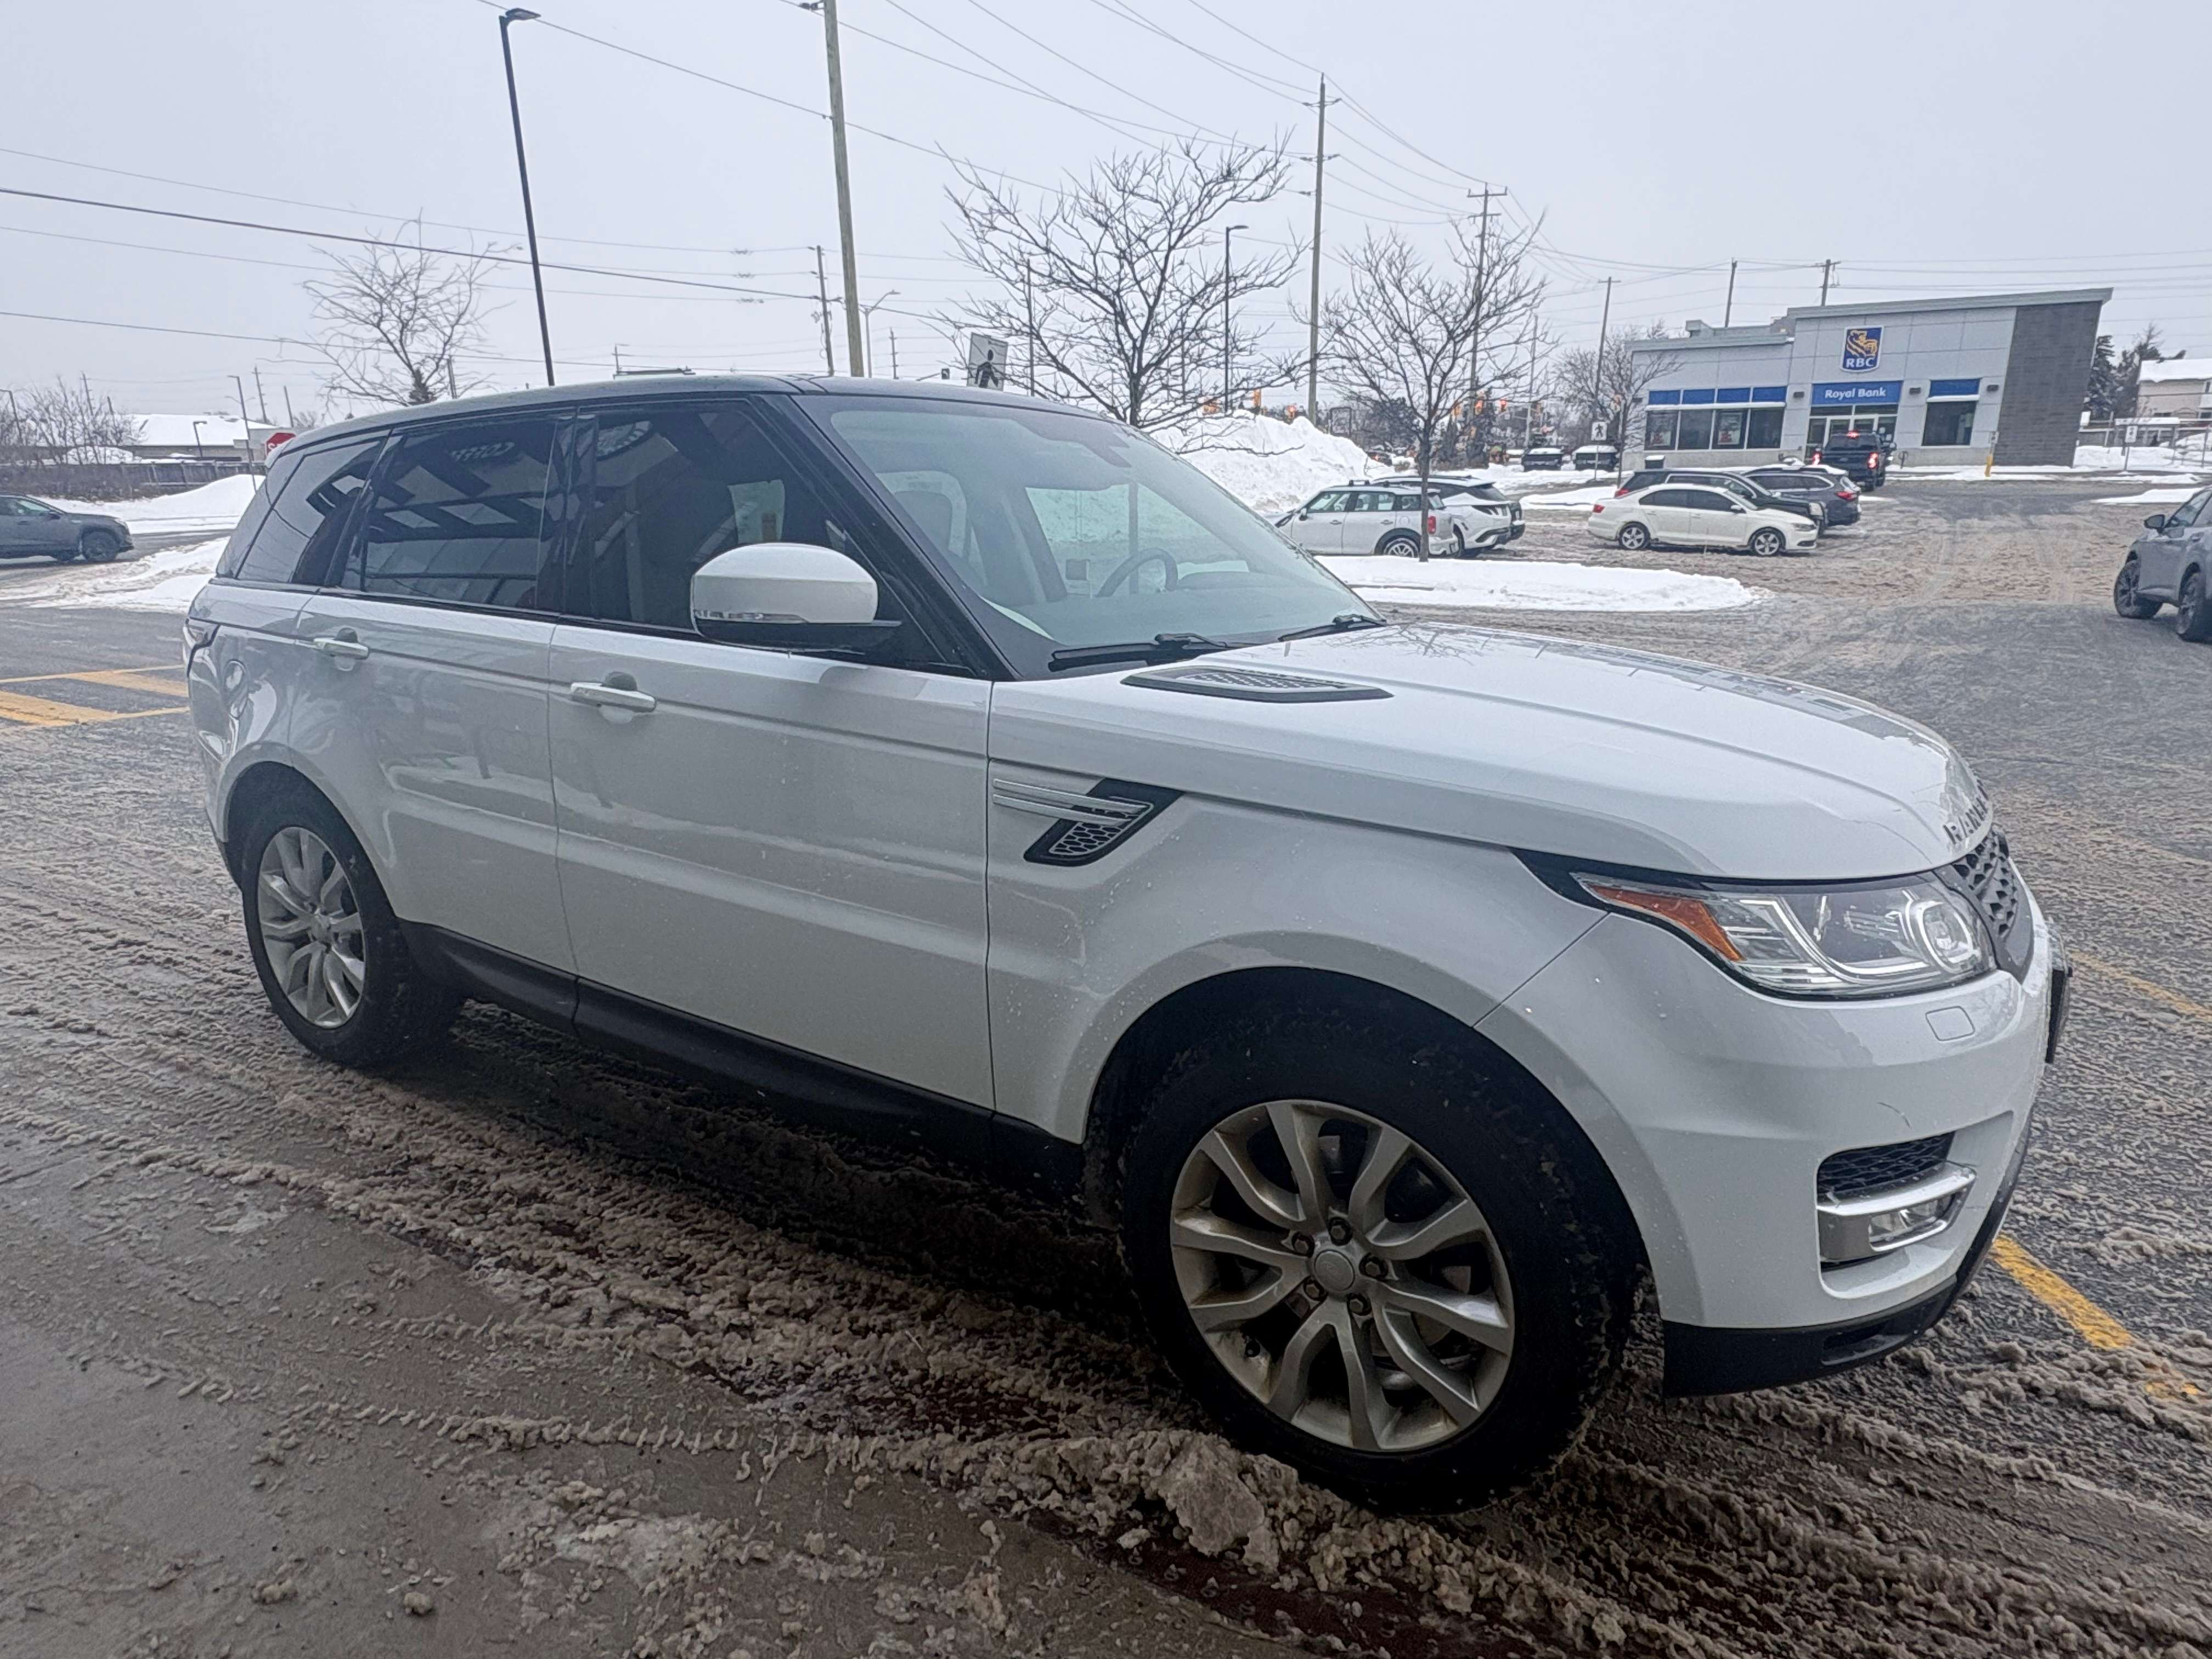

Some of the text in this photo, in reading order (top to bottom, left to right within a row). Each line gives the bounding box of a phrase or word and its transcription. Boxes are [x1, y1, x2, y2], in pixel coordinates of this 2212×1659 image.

[1846, 357, 1875, 368] RBC
[1825, 387, 1886, 400] Royal Bank
